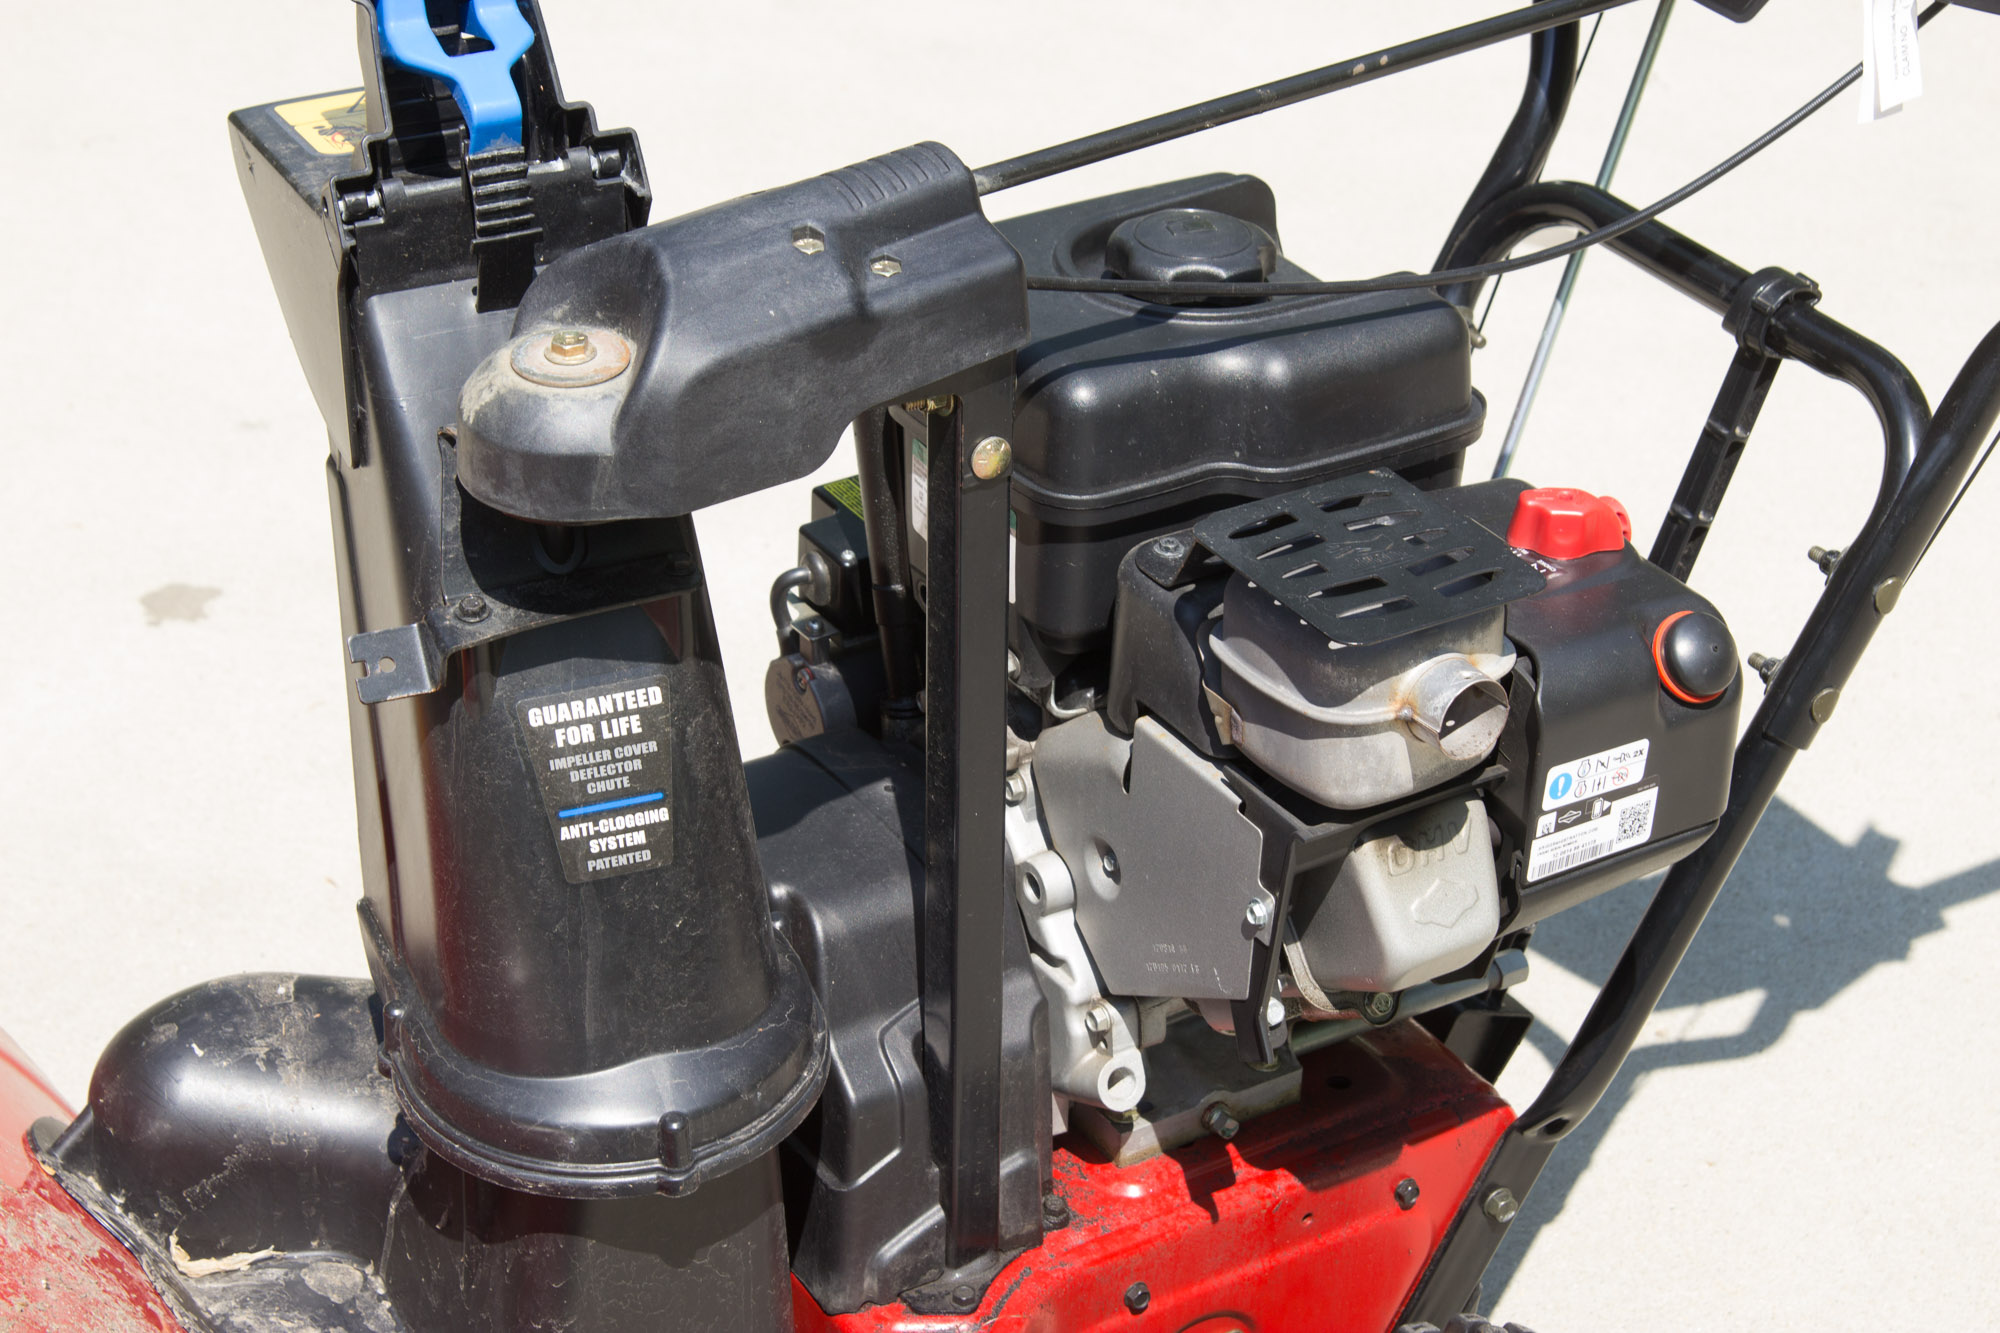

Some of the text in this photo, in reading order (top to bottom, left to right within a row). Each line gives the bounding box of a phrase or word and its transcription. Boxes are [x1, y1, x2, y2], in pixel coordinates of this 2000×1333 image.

[528, 686, 662, 727] GUARANTEED
[555, 714, 642, 748] FOR LIFE
[549, 740, 657, 771] IMPELLER COVER
[1633, 748, 1645, 758] 2X
[569, 758, 642, 783] DEFLECTOR
[587, 776, 630, 794] CHUTE
[560, 807, 669, 840] ANTI-CLOGGING
[589, 830, 646, 853] SYSTEM
[587, 849, 651, 872] PATENTED
